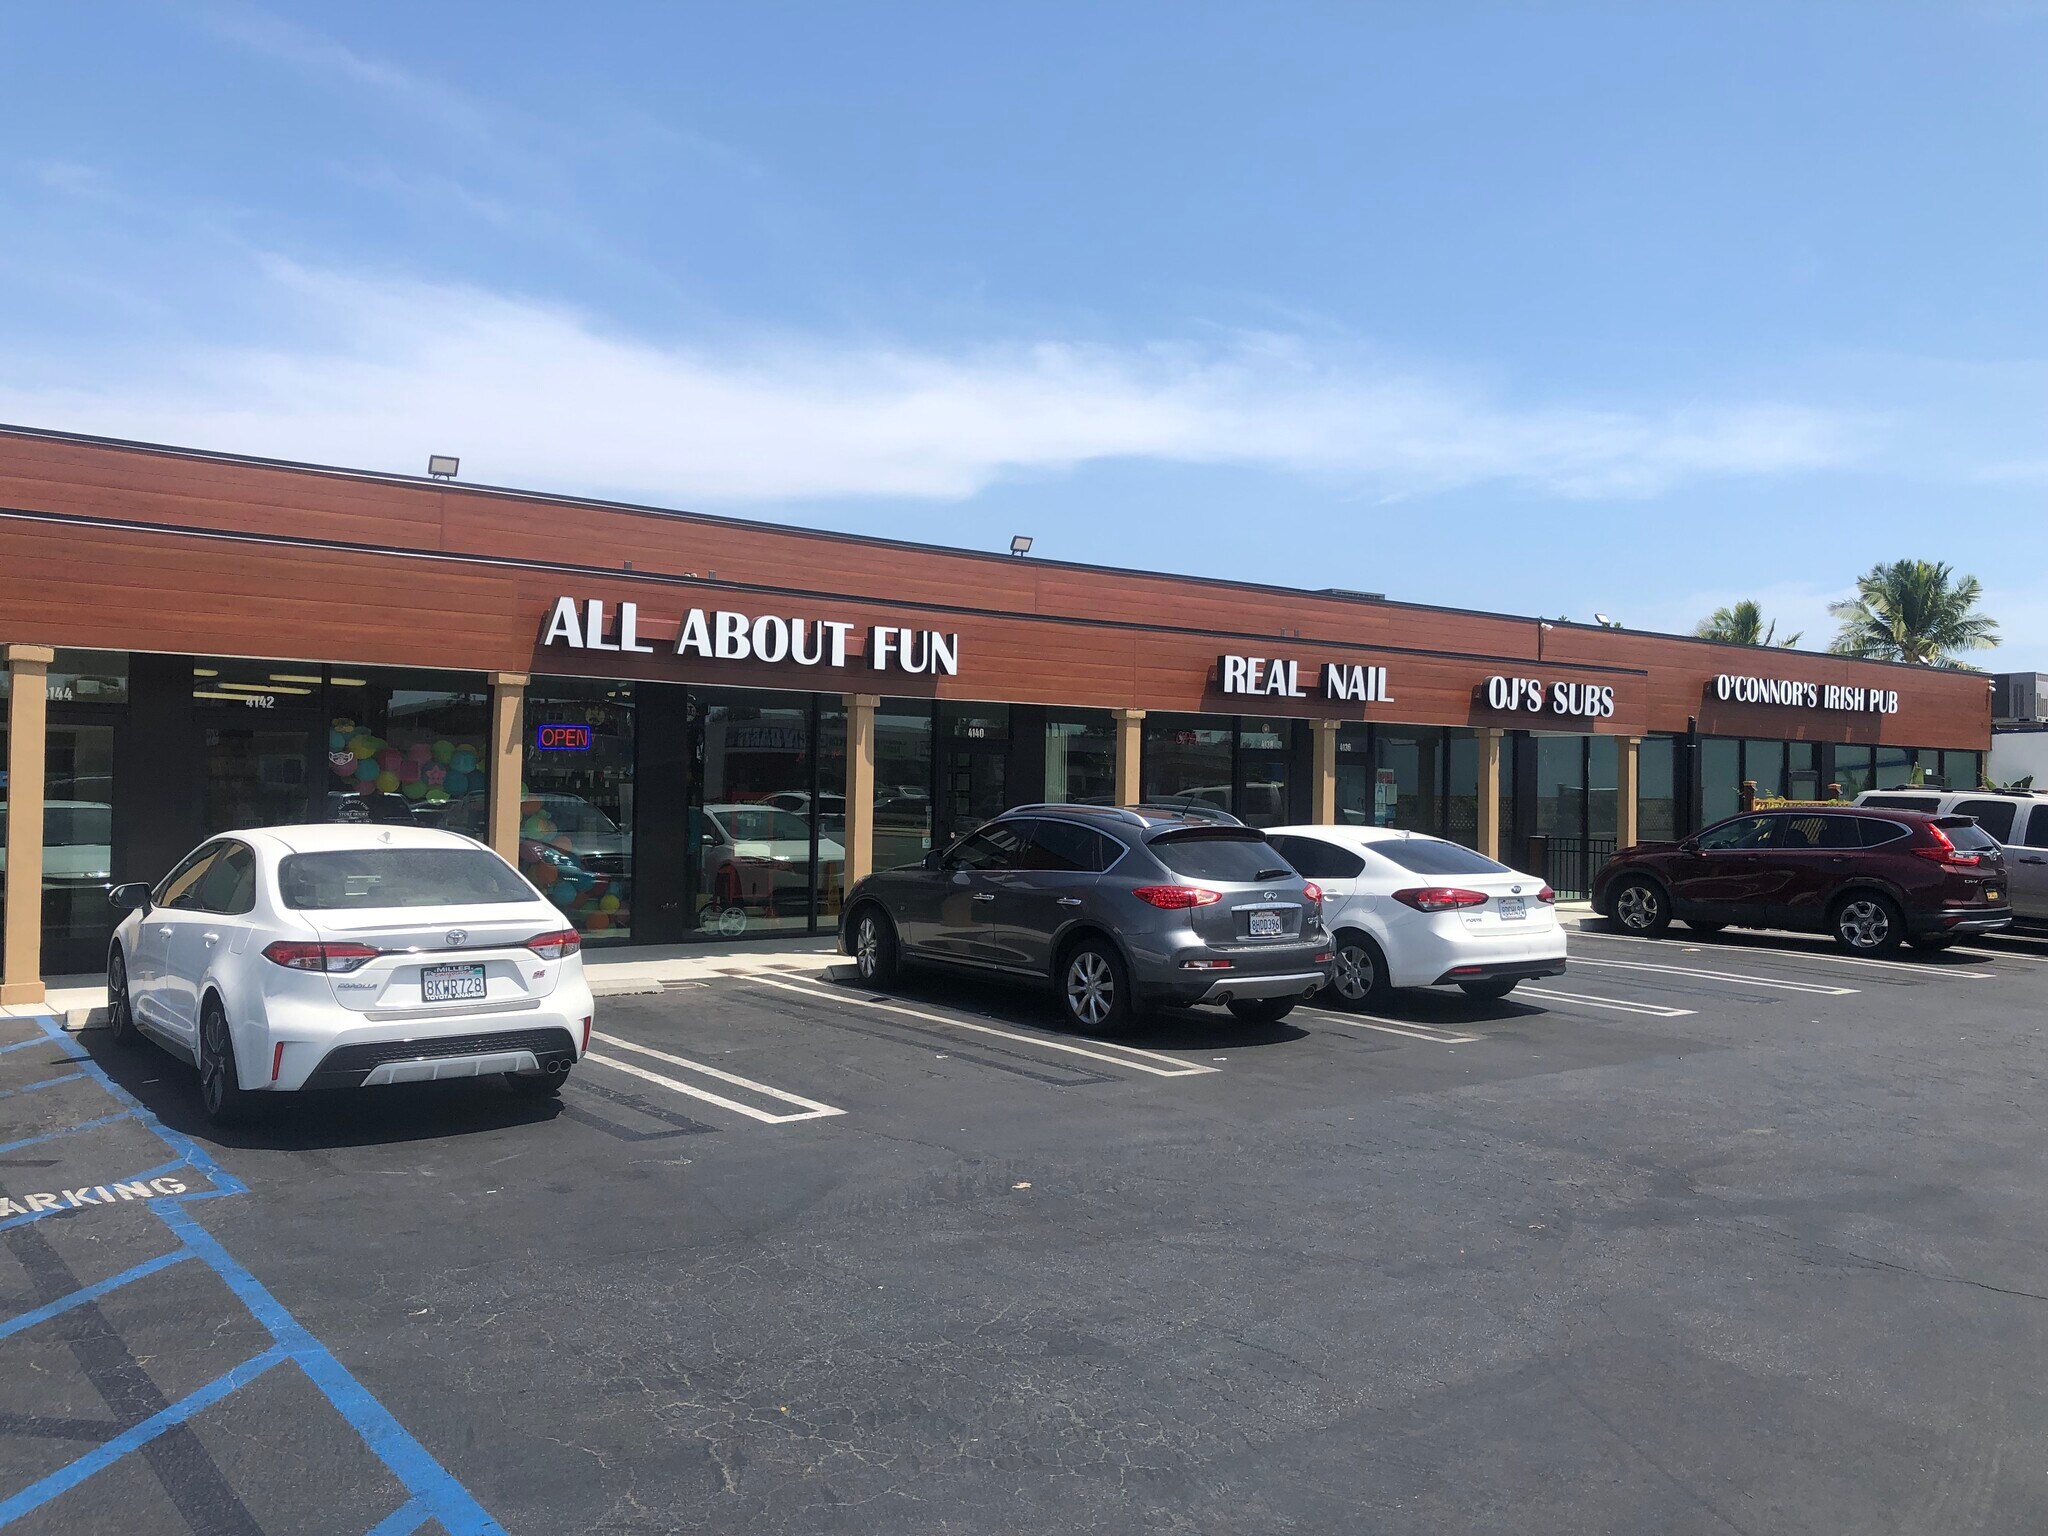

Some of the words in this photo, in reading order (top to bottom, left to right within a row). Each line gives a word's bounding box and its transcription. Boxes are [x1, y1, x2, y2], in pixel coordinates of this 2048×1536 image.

[543, 595, 654, 653] ALL
[676, 607, 855, 667] ABOUT
[872, 625, 958, 676] FUN
[1223, 654, 1307, 698] REAL
[1327, 662, 1395, 702] NAIL
[245, 695, 275, 709] 4142
[1488, 675, 1542, 712] OJ'S
[1553, 681, 1615, 718] SUBS
[1717, 673, 1818, 708] O'CONNOR'S
[1823, 684, 1864, 712] IRISH
[1869, 688, 1899, 714] PUB
[541, 728, 588, 746] OPEN
[967, 728, 985, 738] 4140
[1251, 918, 1280, 931] 8HDD396
[427, 978, 481, 996] 8KWR728
[0, 1177, 187, 1217] ARKING
